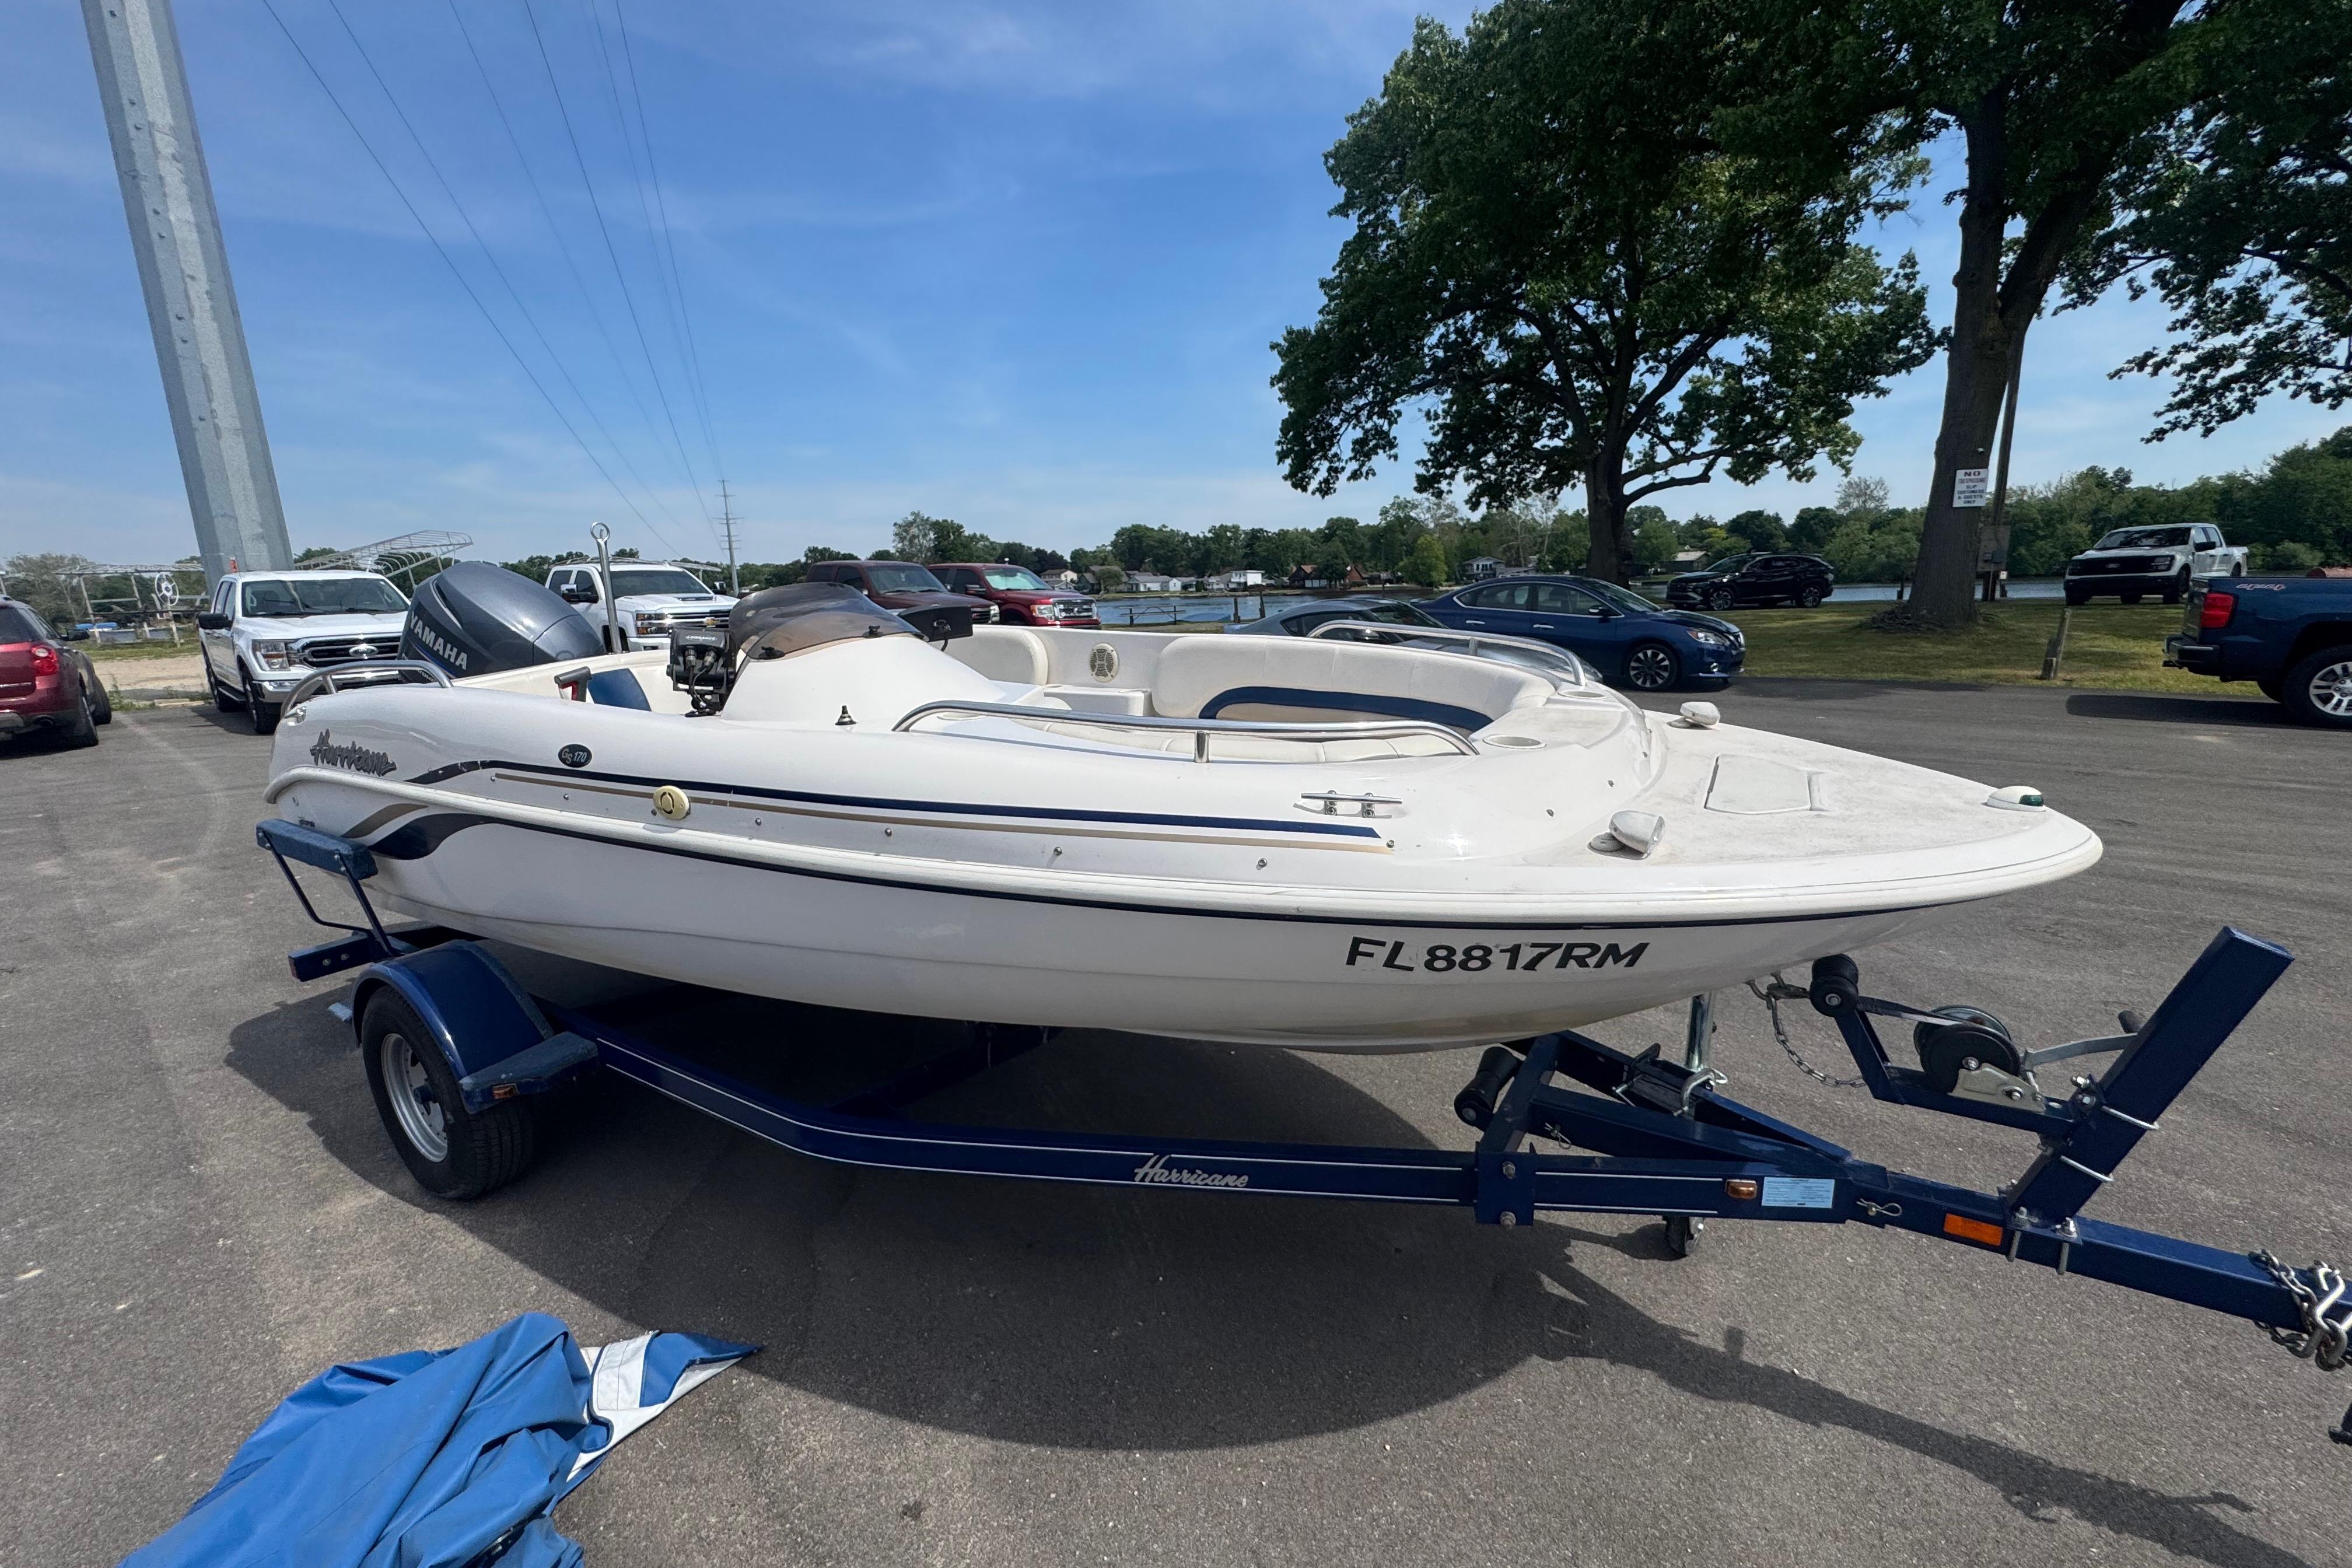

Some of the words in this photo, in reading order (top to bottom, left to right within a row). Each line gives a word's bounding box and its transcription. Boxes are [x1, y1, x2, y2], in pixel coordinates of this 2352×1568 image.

[410, 611, 468, 670] YAMAHA
[310, 729, 397, 777] Hurricane
[573, 751, 587, 762] 170
